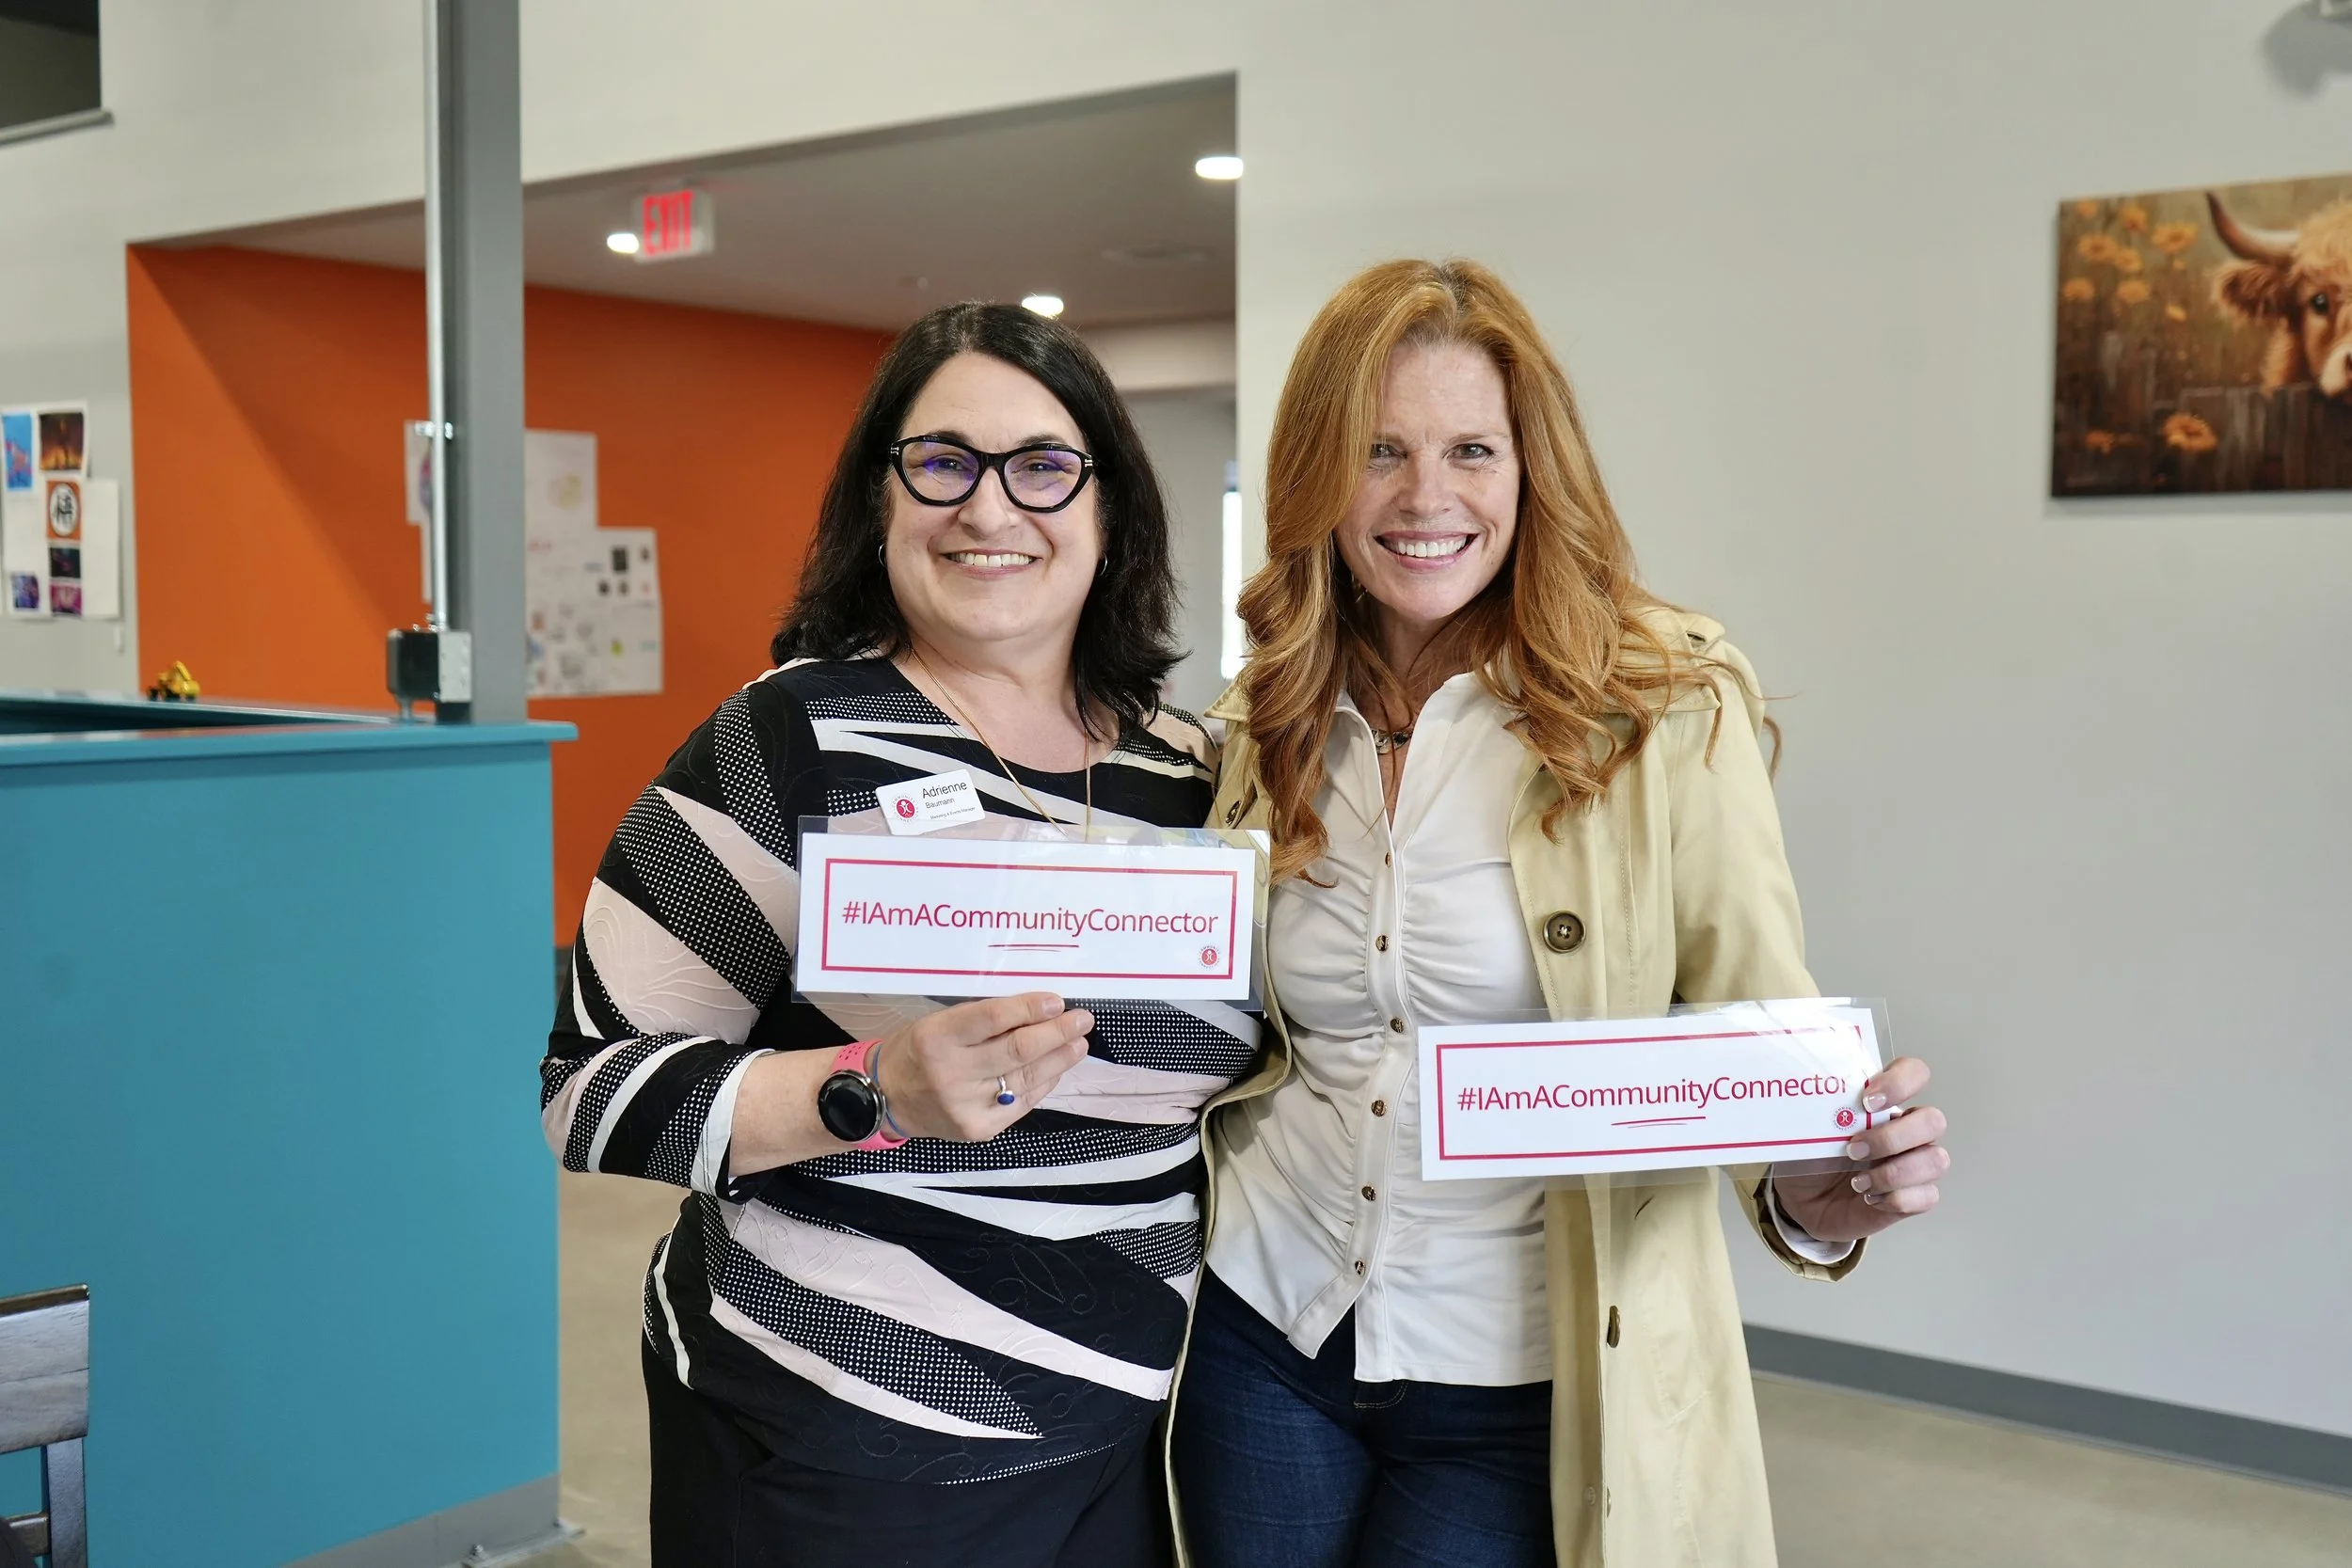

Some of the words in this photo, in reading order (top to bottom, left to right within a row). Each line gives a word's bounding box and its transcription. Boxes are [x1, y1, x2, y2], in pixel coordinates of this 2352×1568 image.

[644, 189, 692, 257] EXIT
[922, 782, 967, 799] Adrienne
[925, 798, 955, 809] Baumann
[842, 901, 1218, 938] #IAmACommunityConnector
[1456, 1074, 1849, 1111] #IAmACommunityConnector
